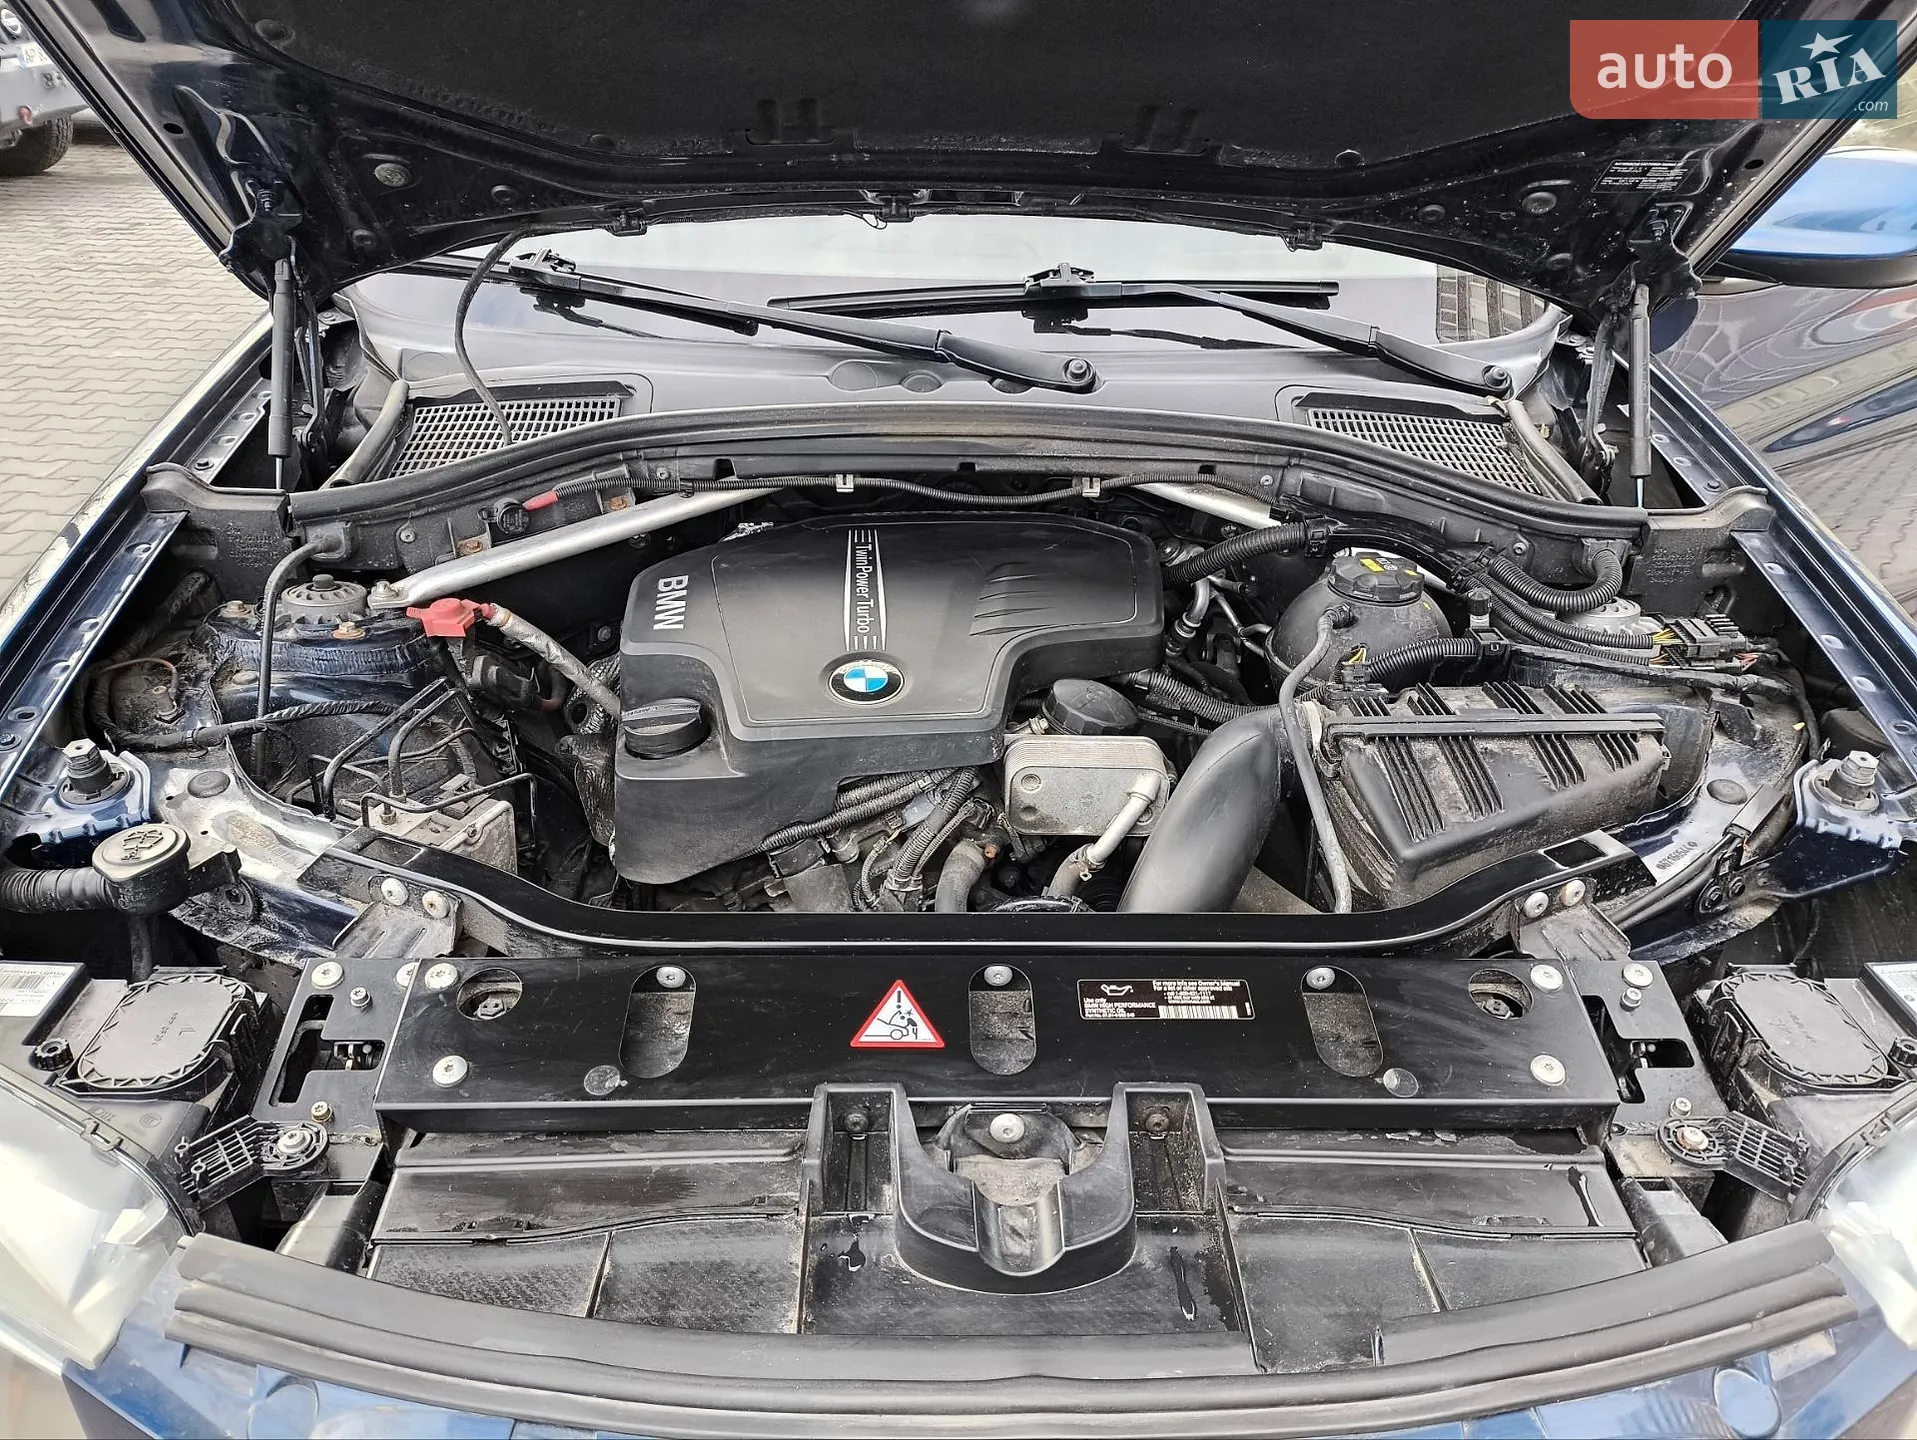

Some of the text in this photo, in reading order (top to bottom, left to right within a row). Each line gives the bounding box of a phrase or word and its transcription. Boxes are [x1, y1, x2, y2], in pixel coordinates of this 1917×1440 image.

[653, 574, 689, 630] BMW
[855, 544, 875, 634] TwinPower Turbo
